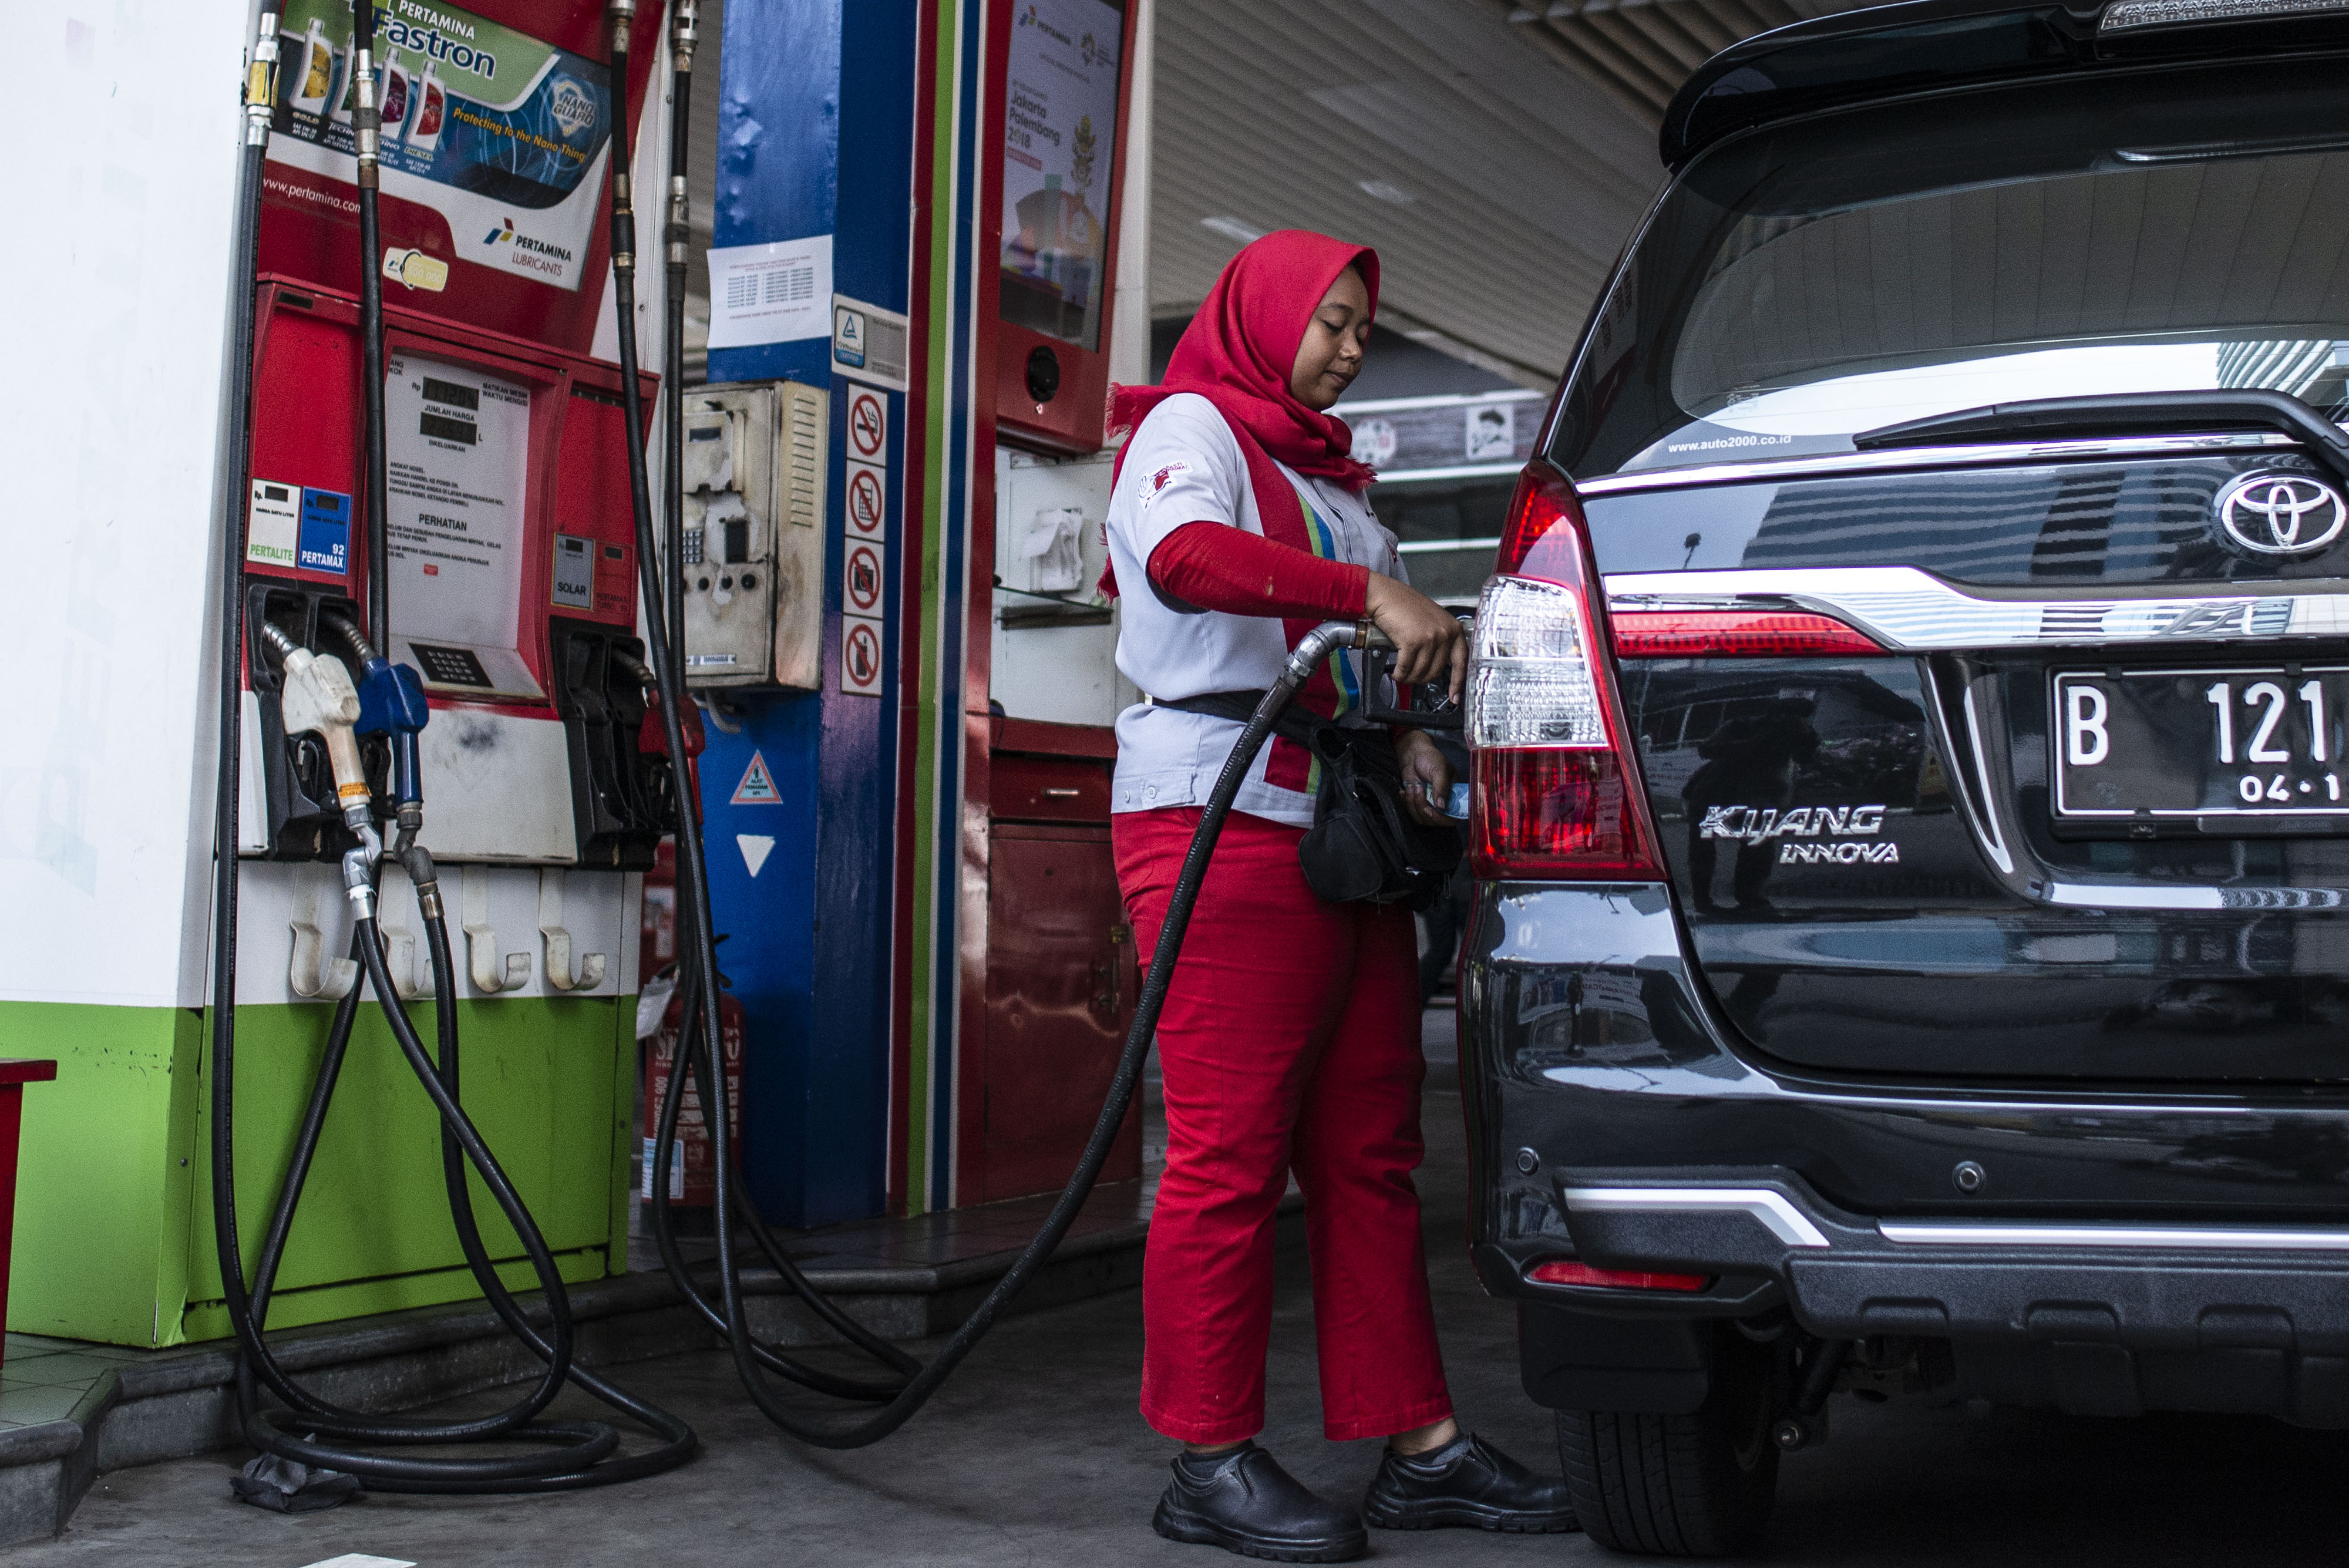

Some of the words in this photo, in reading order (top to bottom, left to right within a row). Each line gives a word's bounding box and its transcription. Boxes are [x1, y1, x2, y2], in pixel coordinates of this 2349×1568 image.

[399, 0, 474, 40] PERTAMINA
[372, 6, 495, 79] Fastron
[562, 95, 594, 112] NANO
[1011, 90, 1047, 120] Jakarta
[329, 123, 354, 136] TECHN
[453, 107, 502, 135] Protecting
[504, 125, 514, 137] to
[516, 129, 531, 143] the
[534, 135, 558, 152] Nano
[561, 143, 586, 164] Thing
[1009, 106, 1060, 147] Palembang
[516, 235, 572, 262] PERTAMINA
[512, 252, 562, 277] LUBRICANTS
[412, 382, 420, 391] Rp
[483, 383, 509, 395] MATIKAN
[510, 388, 527, 399] MESIN
[482, 390, 503, 401] WAKTU
[505, 395, 528, 407] MENGISI
[425, 404, 451, 417] JUMLAH
[452, 409, 474, 422] HARGA
[429, 440, 466, 453] DIKELUARKAN
[1668, 435, 1792, 453] www.auto2000.co.id
[419, 513, 467, 531] PERHATIAN
[250, 544, 294, 561] PERTALITE
[332, 543, 345, 556] 92
[302, 550, 344, 568] PERTAMAX
[557, 581, 587, 597] SOLAR
[2067, 685, 2109, 766] B
[2206, 680, 2327, 763] 121
[1699, 806, 1887, 846] KIJANG
[1780, 843, 1899, 864] INNOVA
